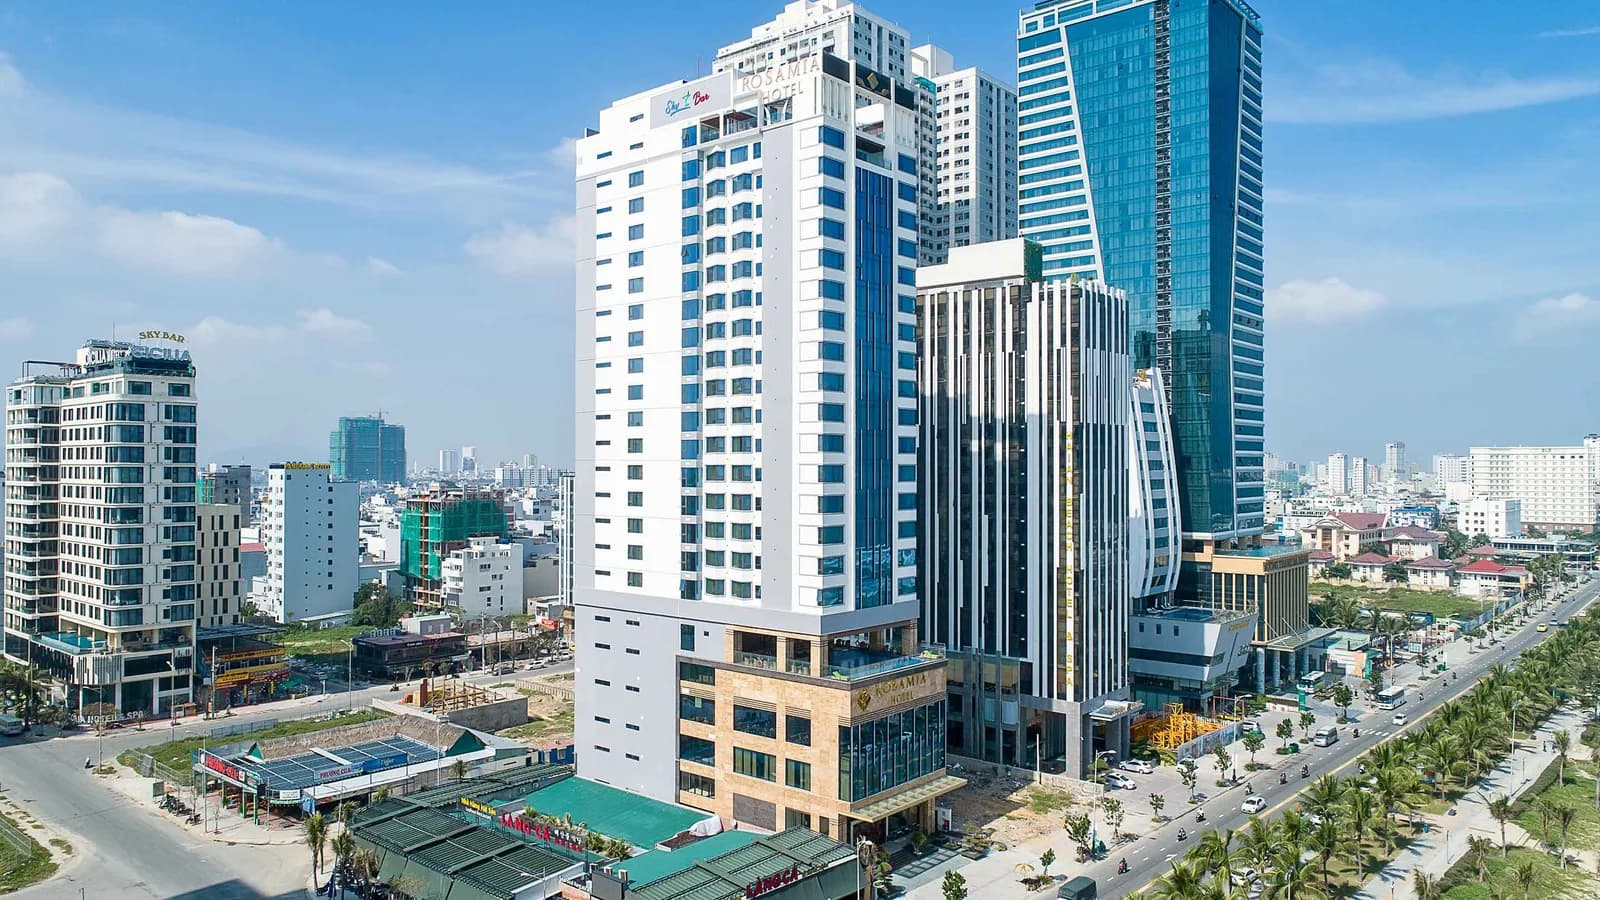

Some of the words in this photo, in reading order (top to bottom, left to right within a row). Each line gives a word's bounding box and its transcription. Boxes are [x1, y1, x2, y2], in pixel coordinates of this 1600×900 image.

[743, 57, 820, 92] ROSAMIA
[693, 91, 710, 106] Bar
[763, 81, 804, 106] HOTEL
